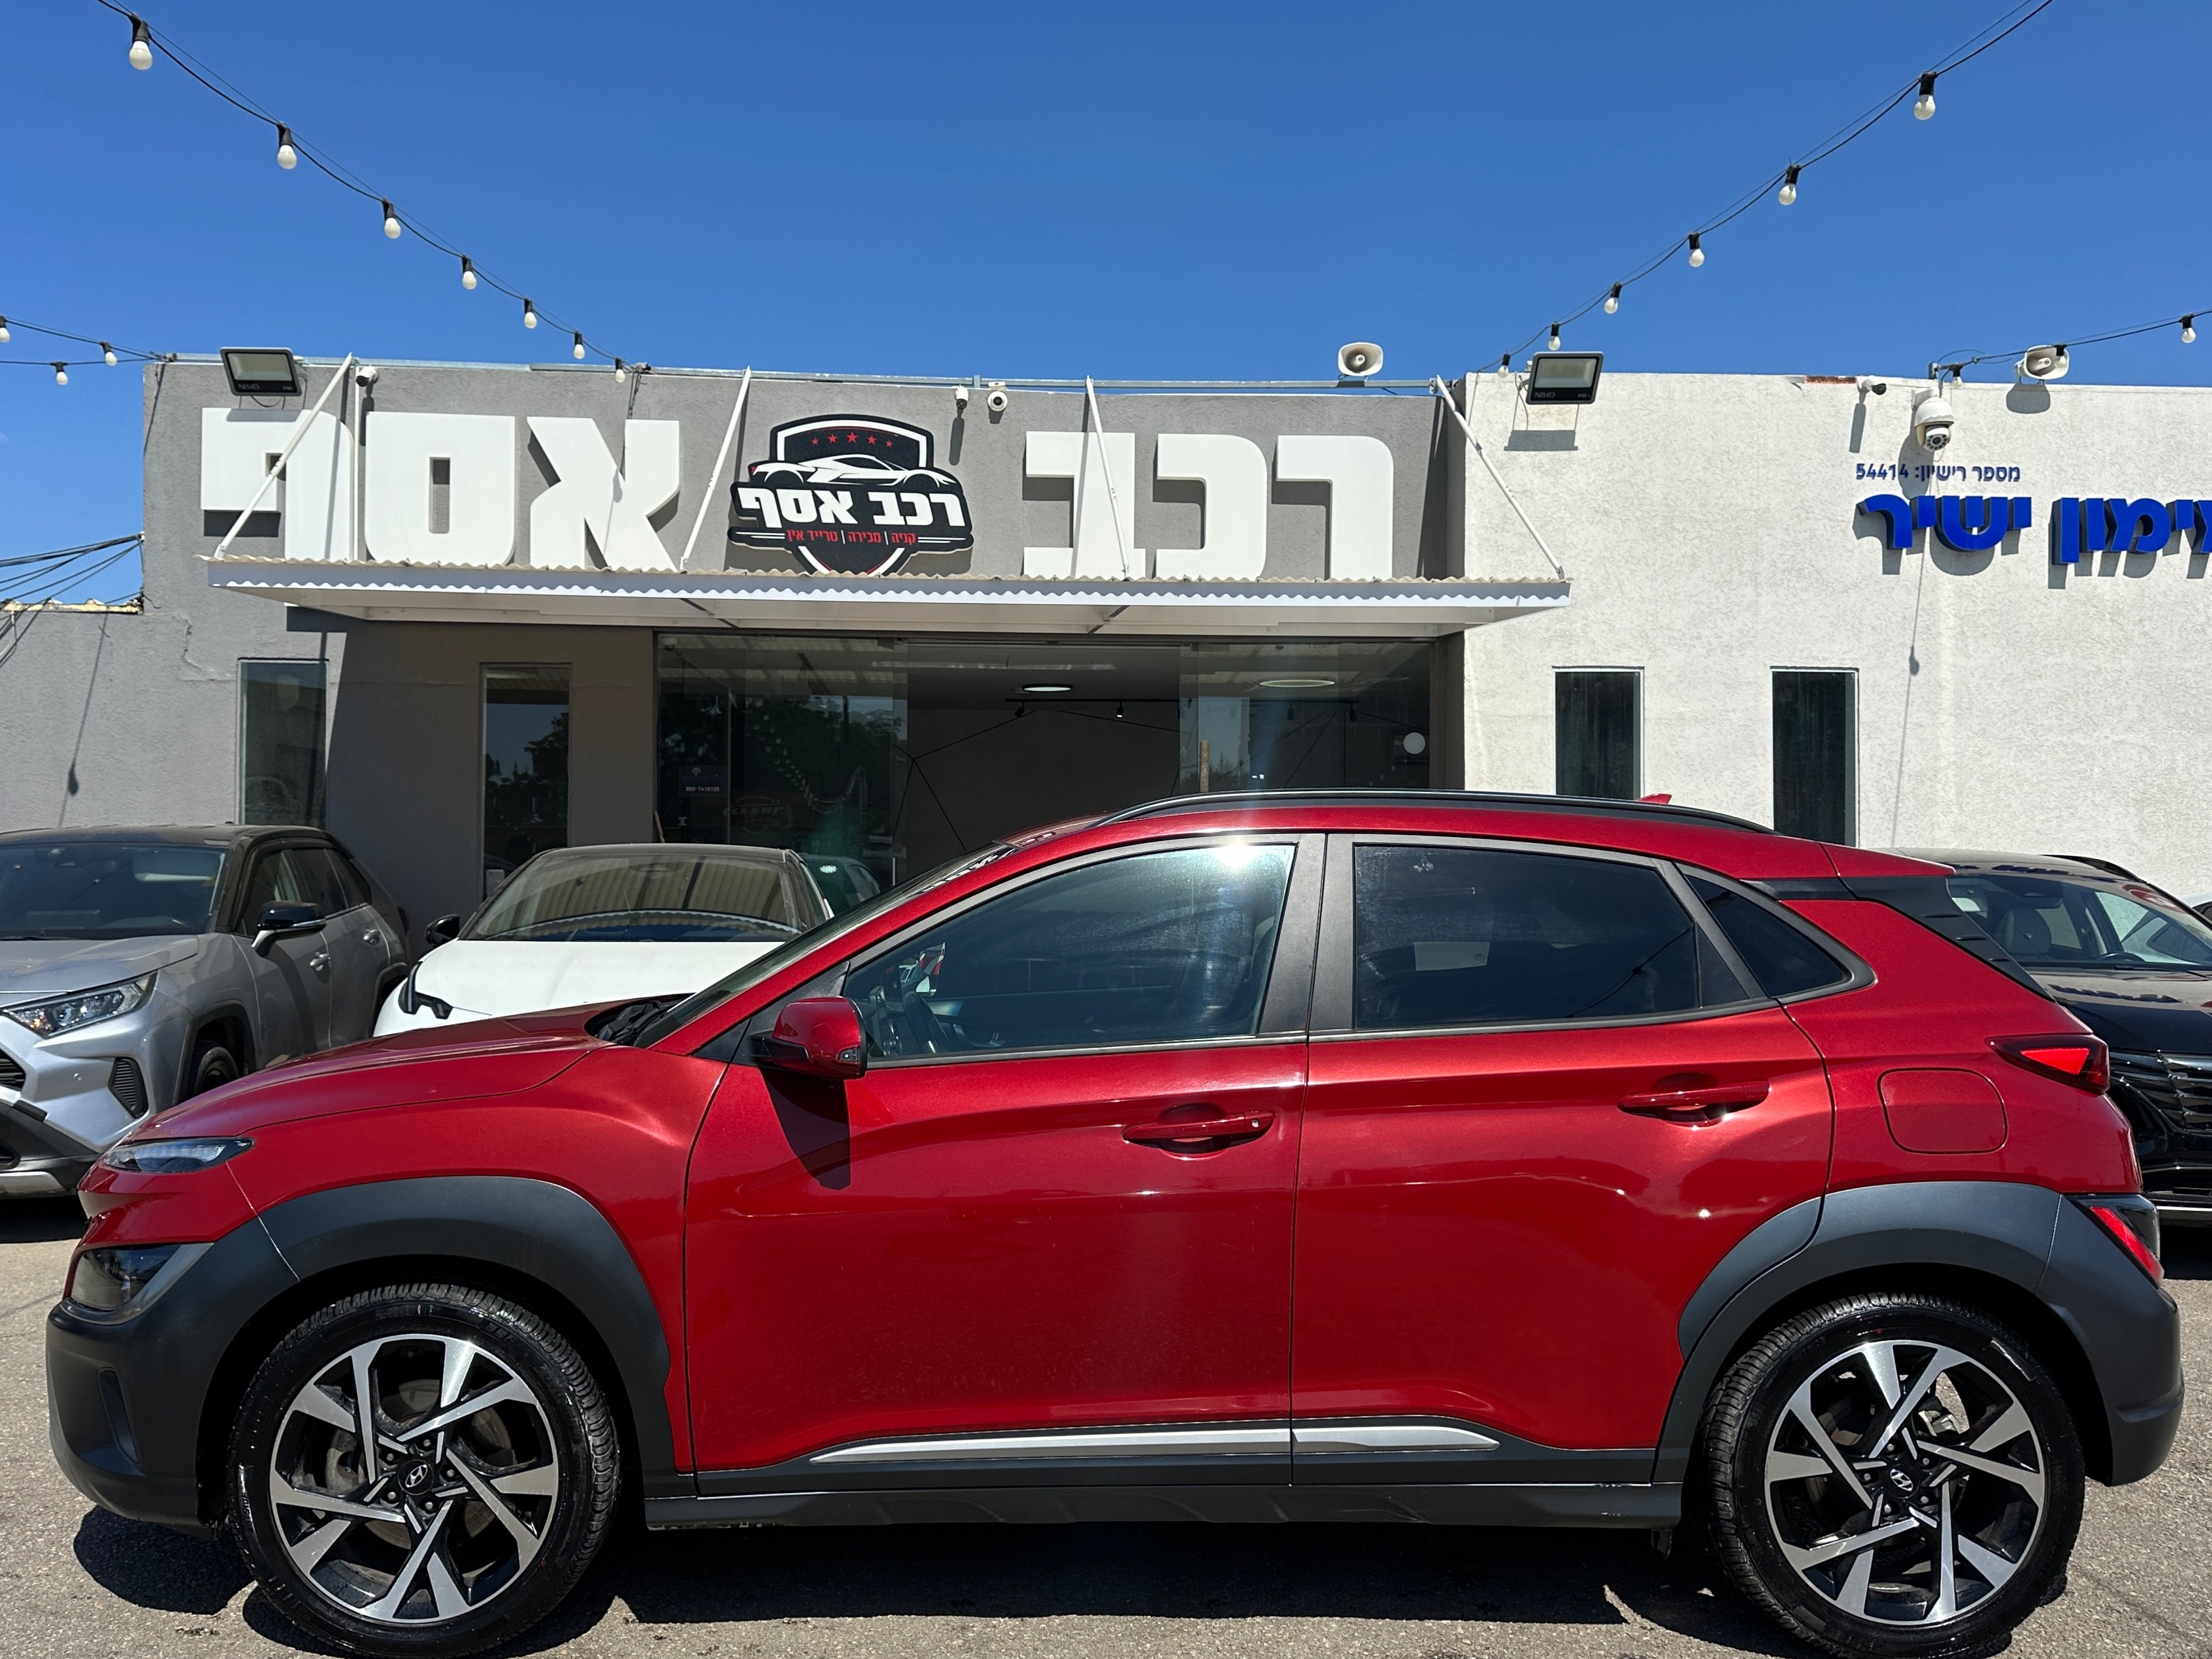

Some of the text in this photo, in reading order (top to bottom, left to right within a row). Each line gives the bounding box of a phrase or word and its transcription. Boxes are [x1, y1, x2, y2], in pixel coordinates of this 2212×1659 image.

[1856, 463, 2021, 482] מספר רישיון: 54414
[201, 408, 1394, 580] רכב אסף
[737, 487, 966, 529] רכב אסף
[787, 529, 916, 545] קניה מכירה טרייד אין
[1861, 494, 2032, 551] ישיר
